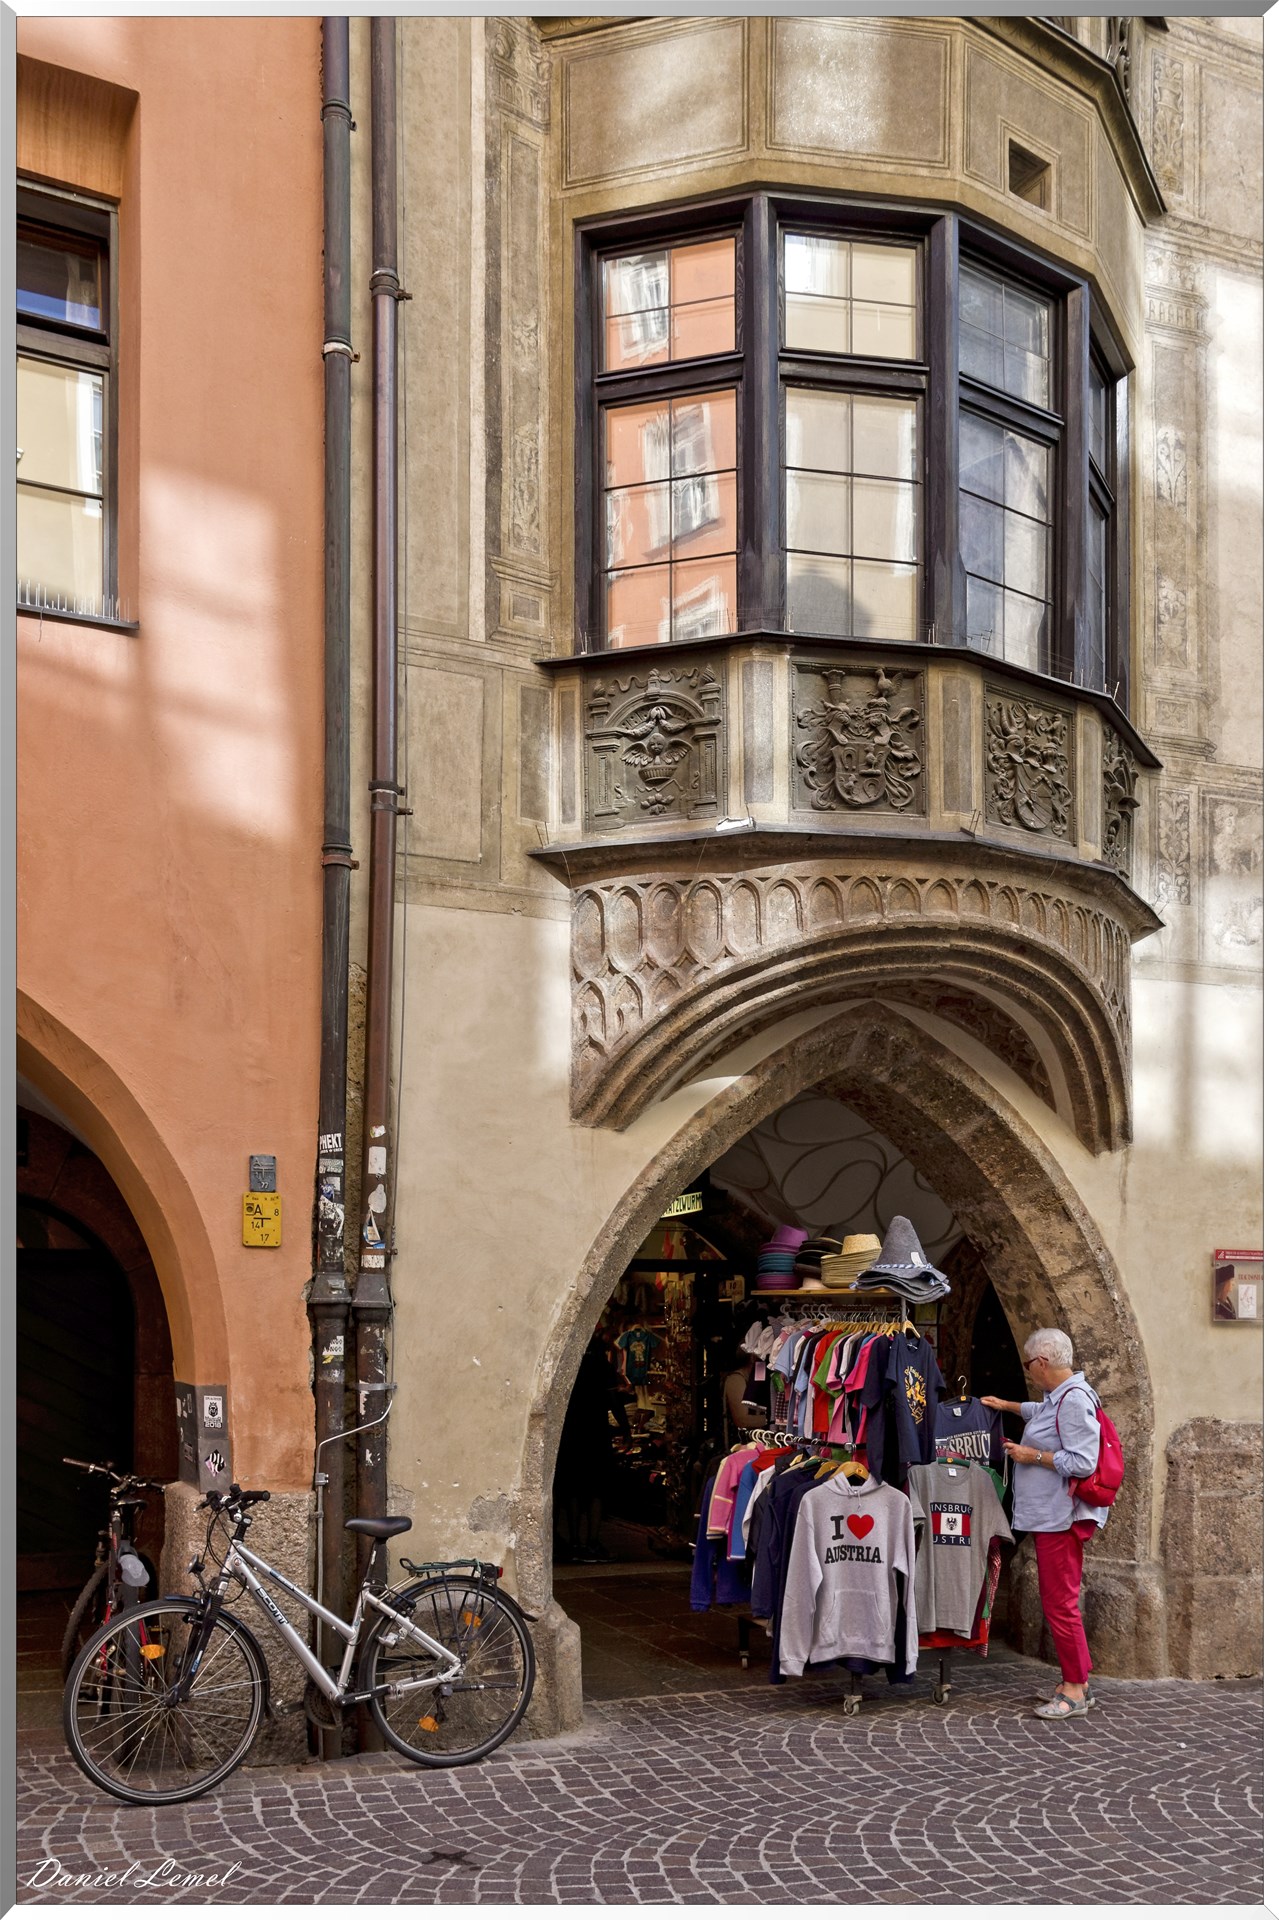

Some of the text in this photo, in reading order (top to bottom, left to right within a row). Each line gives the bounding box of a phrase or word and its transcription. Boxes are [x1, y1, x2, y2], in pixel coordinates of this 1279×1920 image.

[274, 1208, 280, 1217] 8
[251, 1221, 260, 1229] 14
[260, 1234, 270, 1242] 17
[830, 1515, 844, 1541] I
[824, 1544, 882, 1564] AUSTRIA
[255, 1586, 289, 1625] SCOTT
